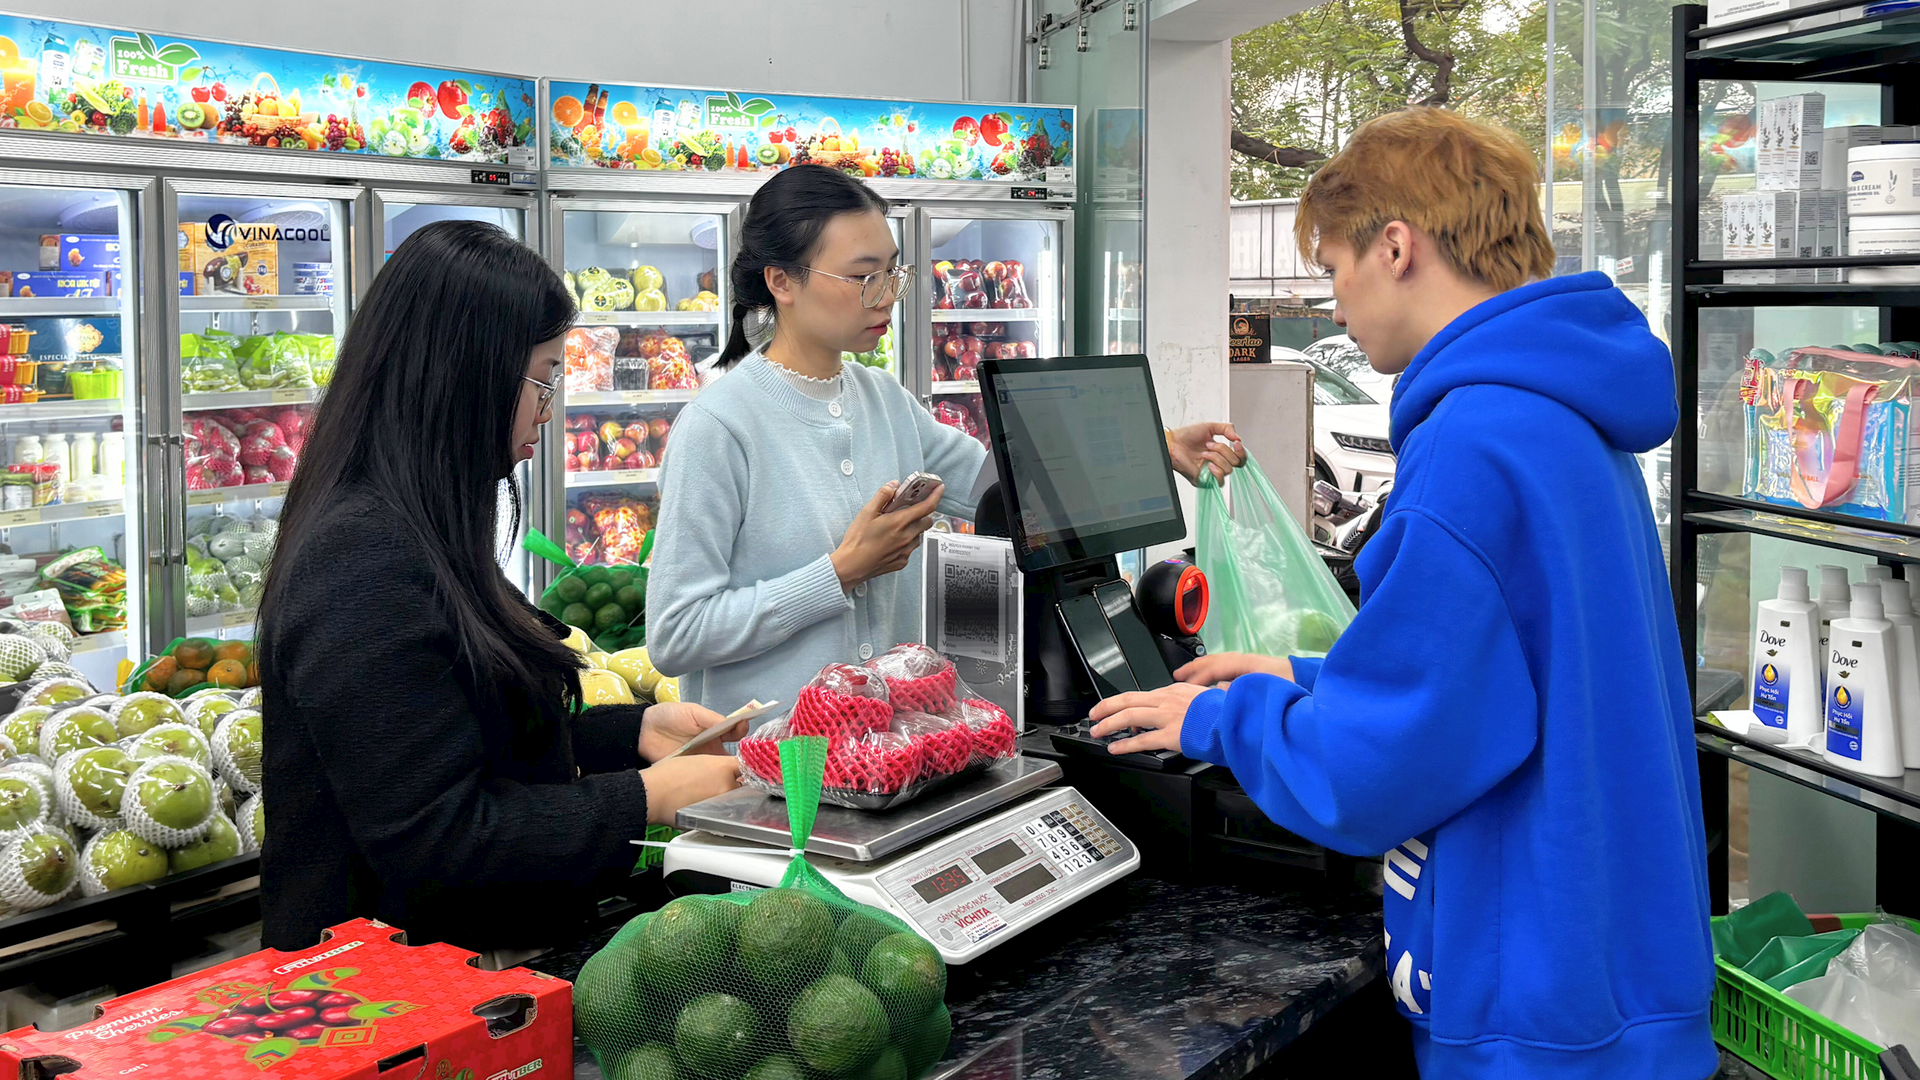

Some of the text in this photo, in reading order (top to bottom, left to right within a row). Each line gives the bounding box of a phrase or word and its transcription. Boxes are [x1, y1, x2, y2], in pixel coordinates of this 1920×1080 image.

[116, 49, 146, 60] 100%
[116, 59, 169, 78] Fresh
[710, 105, 733, 113] 100%
[710, 113, 751, 126] Fresh
[239, 226, 331, 242] VINACOOL
[1229, 336, 1263, 347] eerlao
[1229, 347, 1257, 358] DARK
[1760, 629, 1787, 647] Dove
[1832, 650, 1859, 669] Dove
[1025, 825, 1036, 836] 0
[1037, 829, 1067, 848] 7 8 9
[1051, 850, 1061, 860] 4
[1060, 845, 1071, 856] 5
[1069, 841, 1080, 851] 6
[1064, 853, 1092, 873] 1 2 3
[954, 907, 992, 929] VICHITA
[64, 1006, 164, 1040] Premium
[93, 1010, 184, 1040] Cherries
